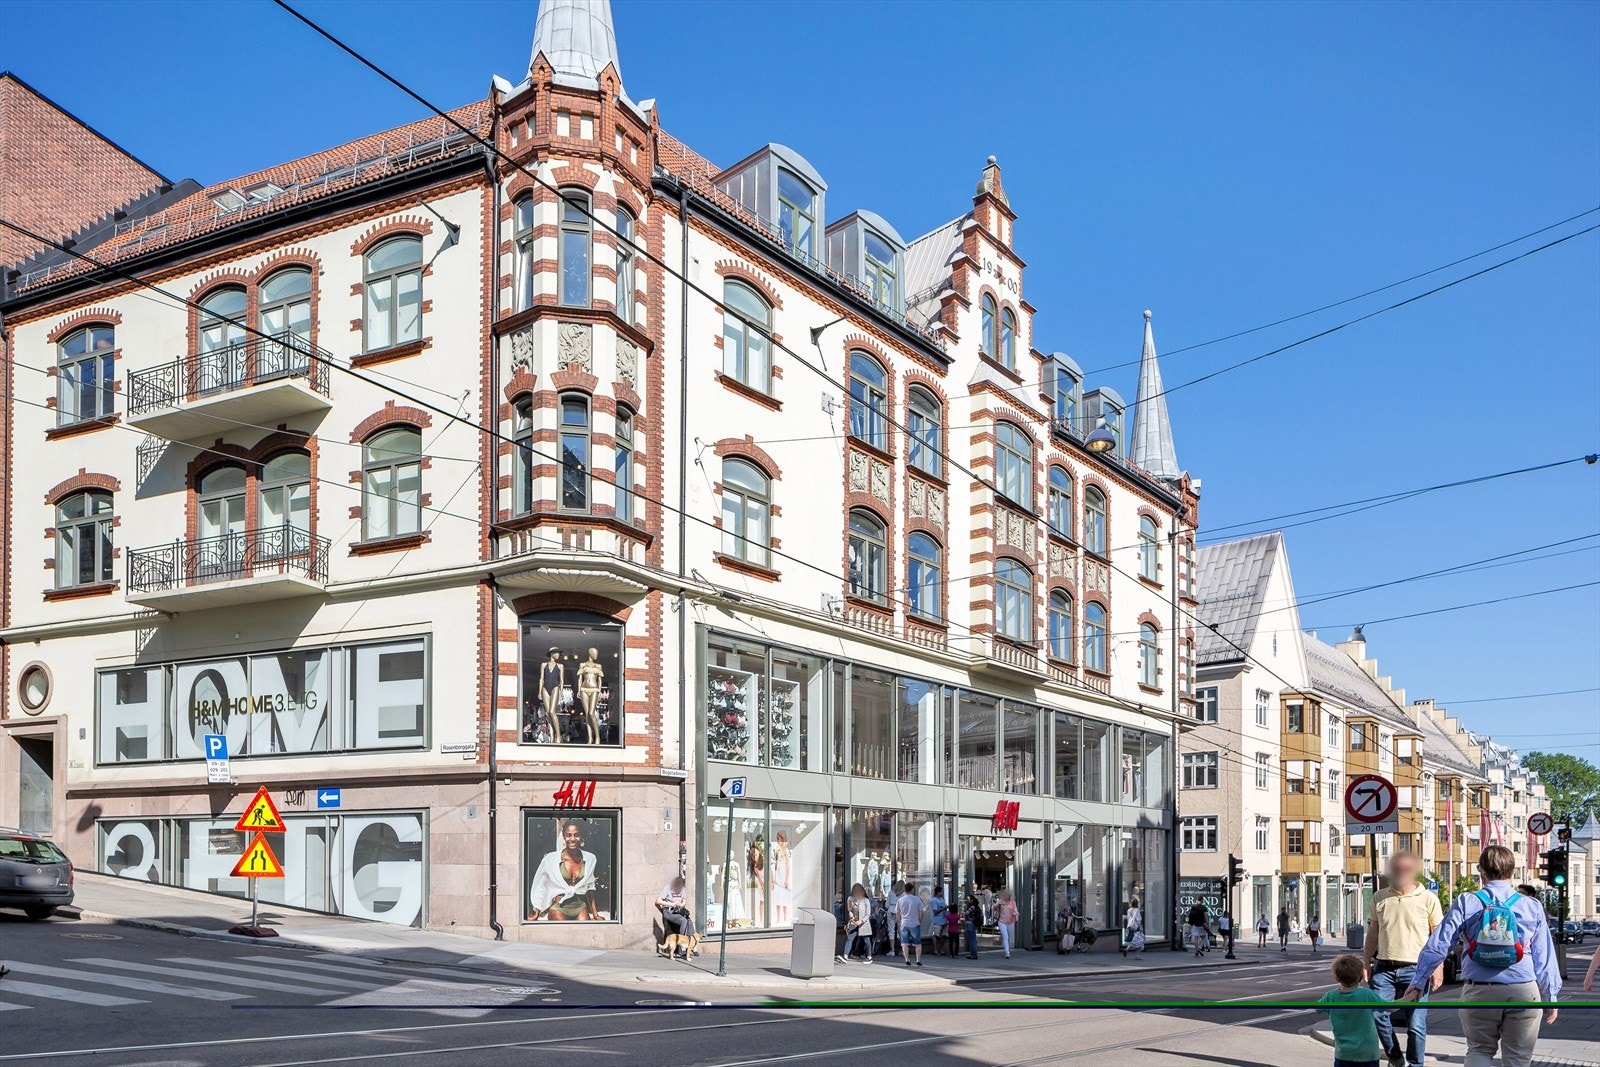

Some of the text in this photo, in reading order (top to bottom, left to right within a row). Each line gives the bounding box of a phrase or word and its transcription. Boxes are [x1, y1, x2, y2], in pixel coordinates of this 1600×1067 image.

[983, 257, 992, 274] 19
[101, 641, 424, 764] HOME
[193, 700, 224, 717] H&M
[228, 694, 273, 716] HOME
[209, 737, 222, 757] P
[553, 779, 597, 809] H&M
[1180, 896, 1218, 905] GRND
